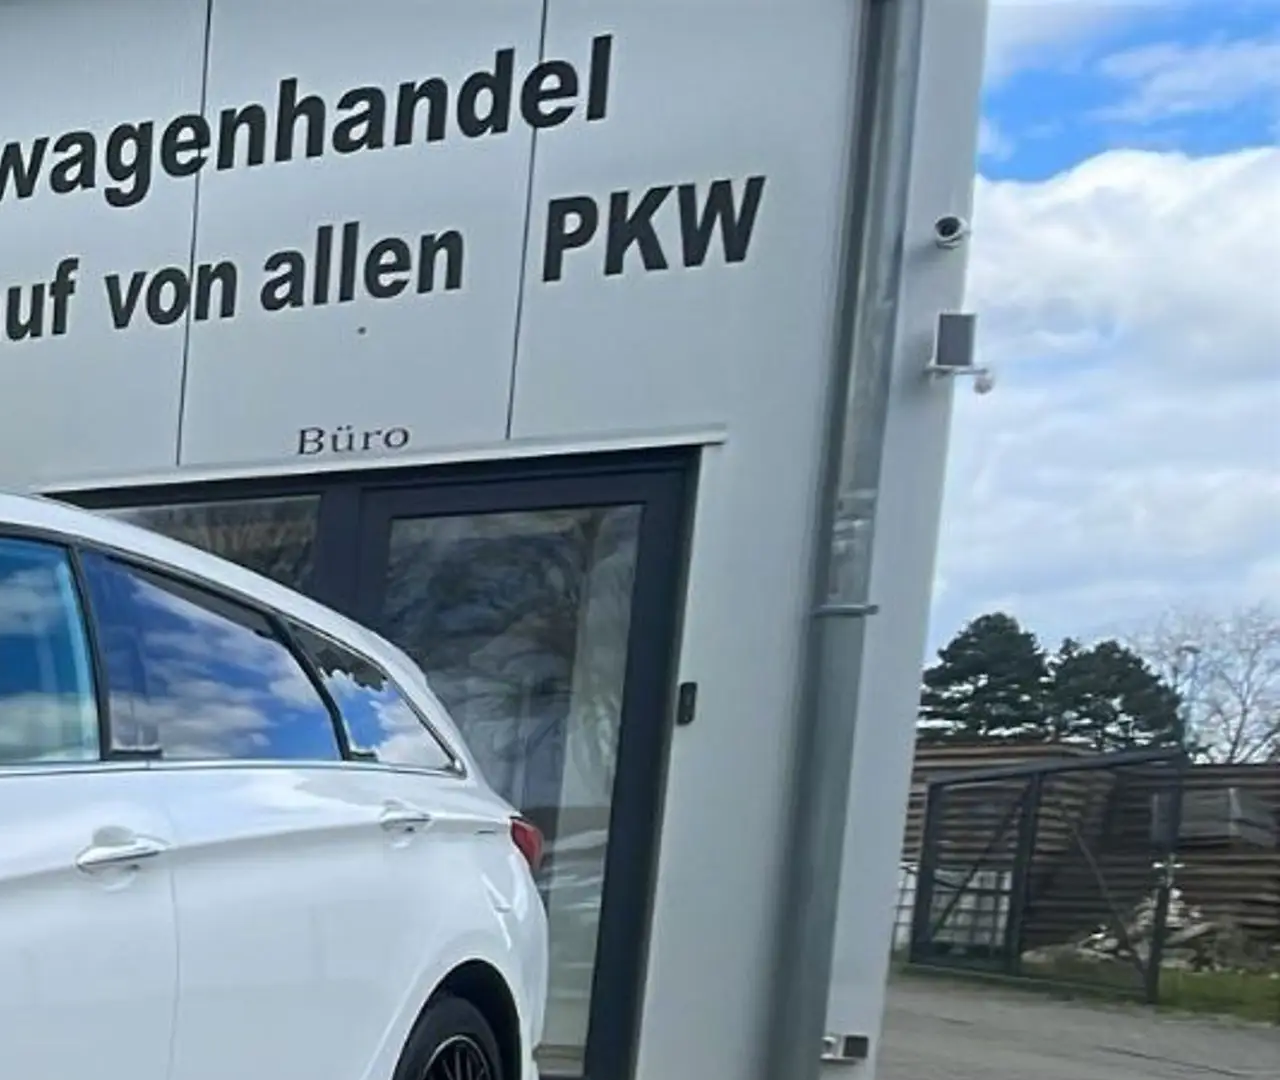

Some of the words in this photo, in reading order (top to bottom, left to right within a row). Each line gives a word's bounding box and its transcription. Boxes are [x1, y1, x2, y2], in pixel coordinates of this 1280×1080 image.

[104, 261, 238, 330] von
[260, 221, 464, 312] allen
[542, 176, 767, 284] PKW
[297, 425, 410, 455] Büro
